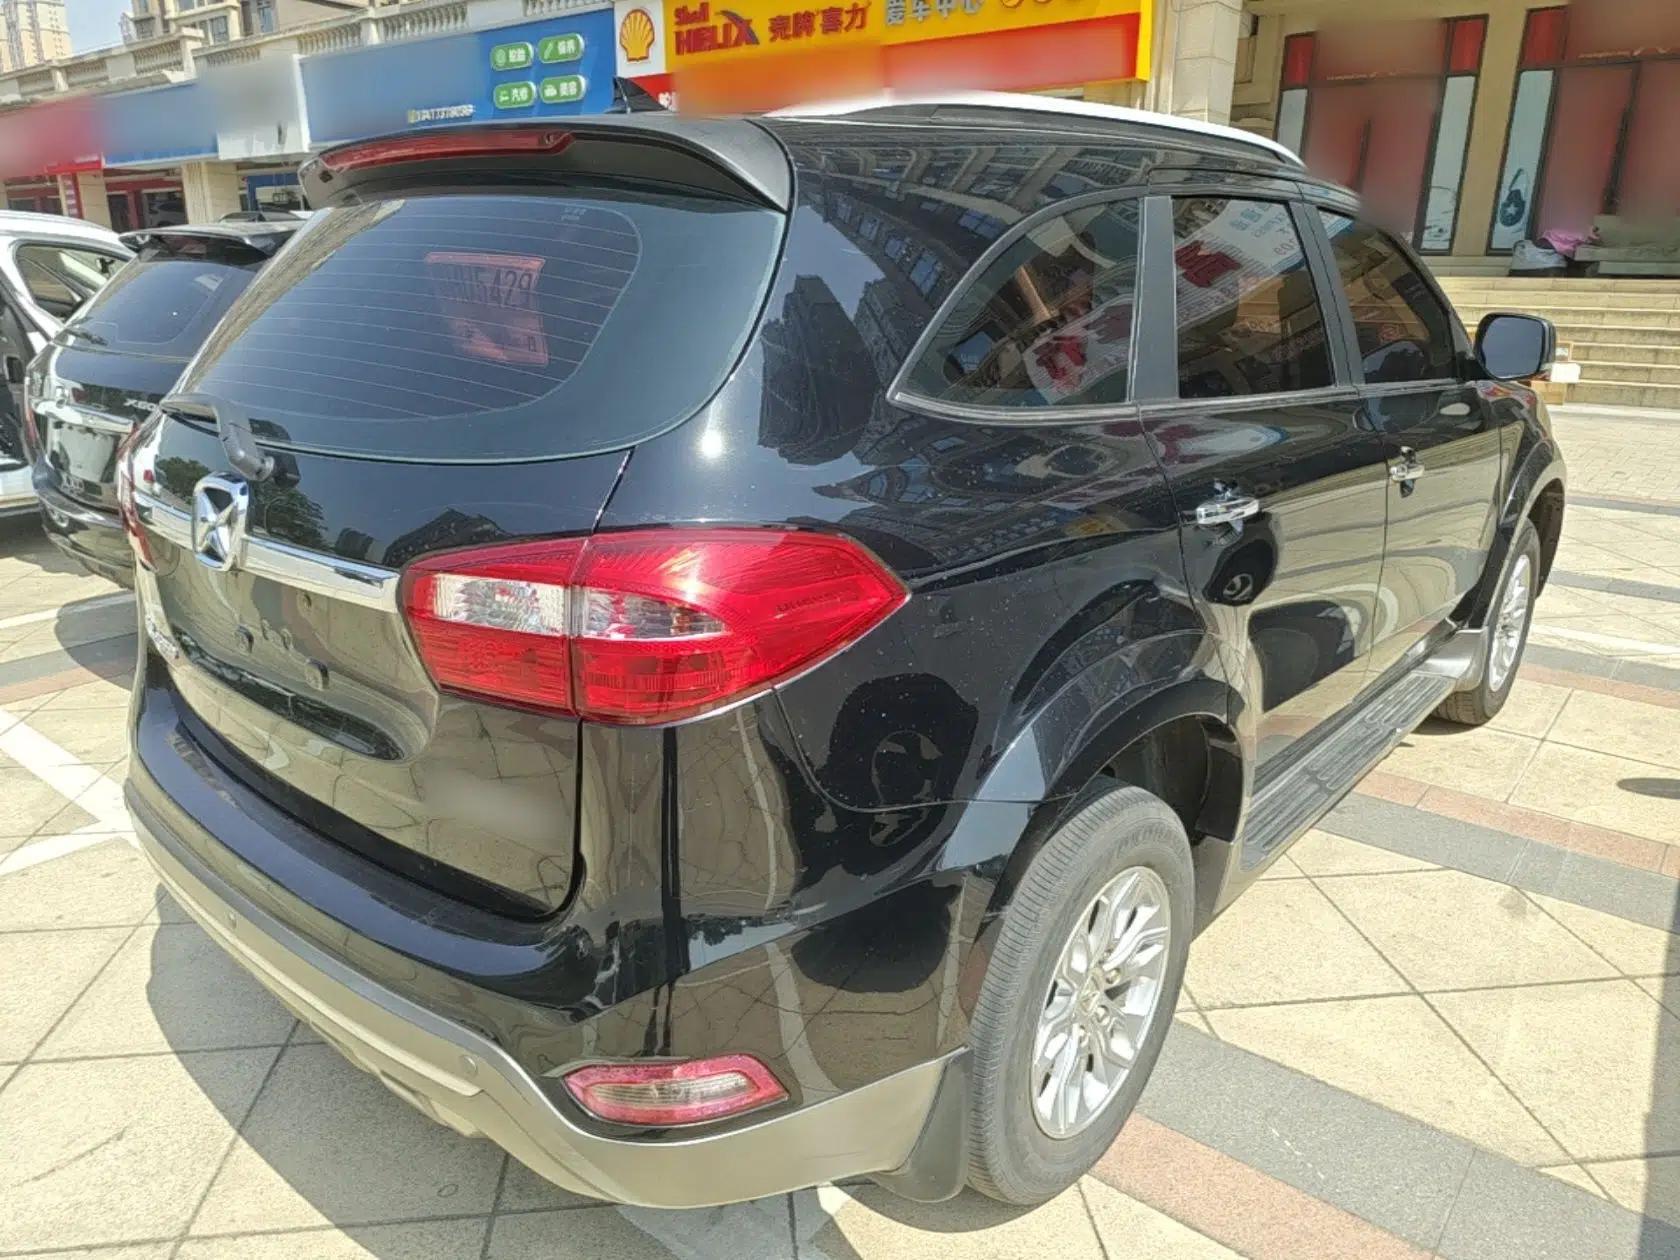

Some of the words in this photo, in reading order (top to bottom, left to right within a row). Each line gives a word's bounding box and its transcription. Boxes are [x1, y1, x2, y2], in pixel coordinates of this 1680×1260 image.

[674, 2, 709, 26] Shell
[768, 4, 869, 42] 壳牌喜力
[674, 20, 755, 56] HELIX
